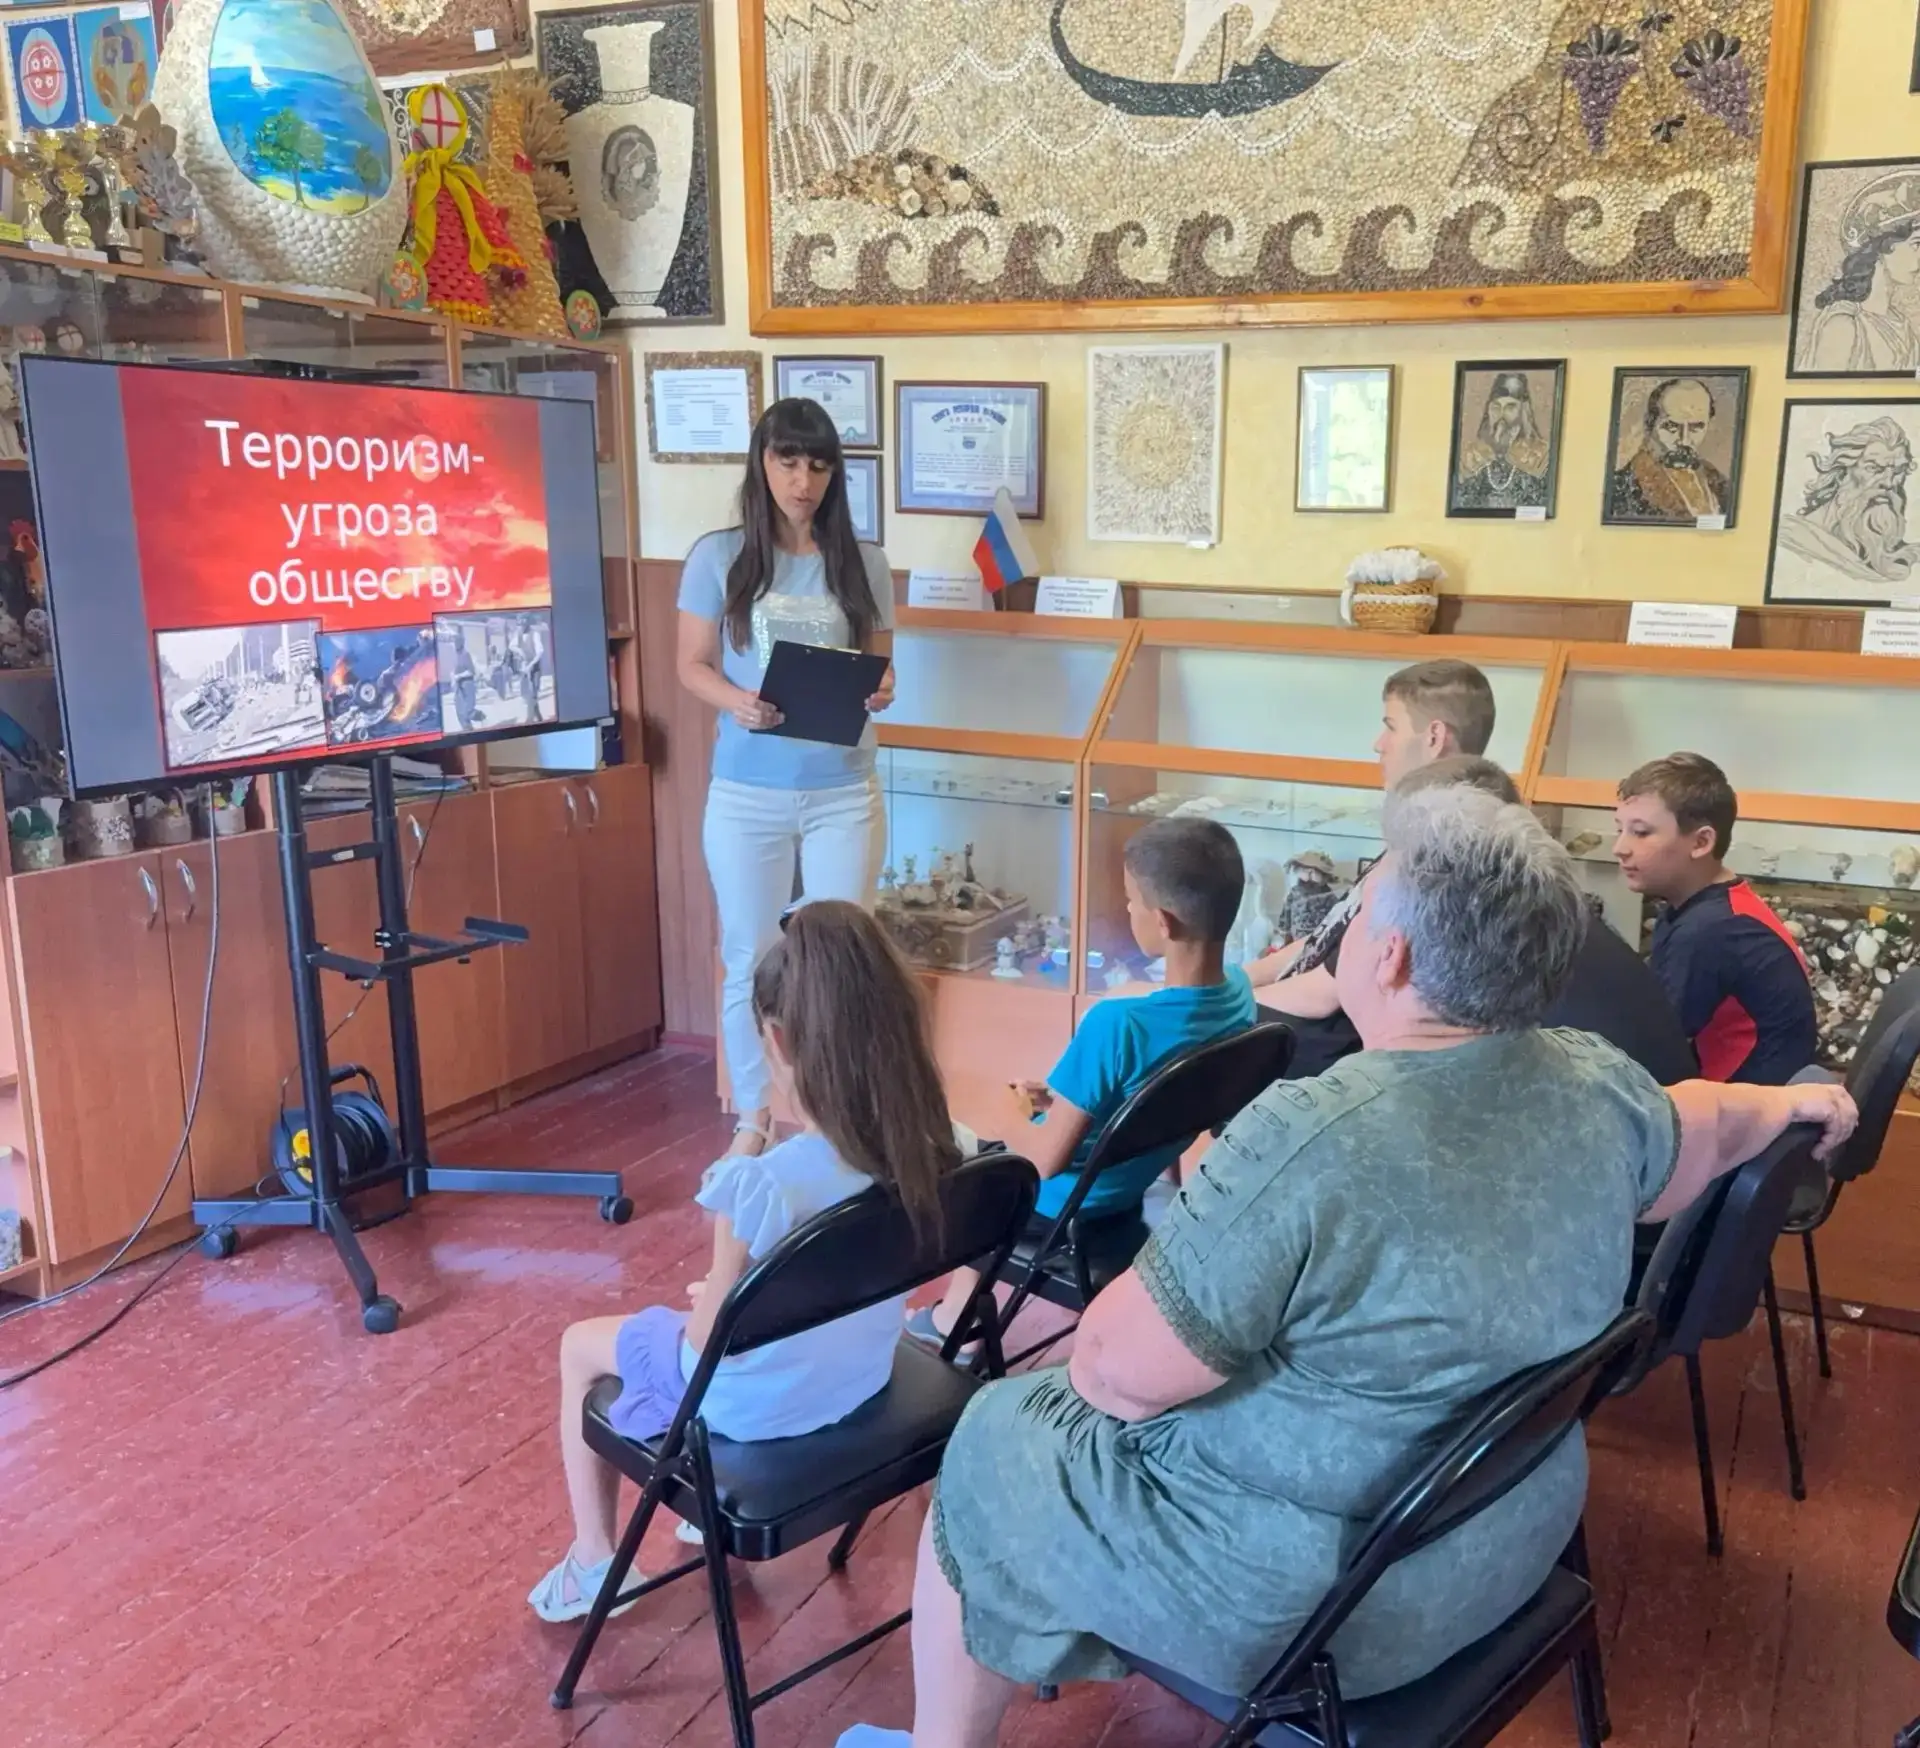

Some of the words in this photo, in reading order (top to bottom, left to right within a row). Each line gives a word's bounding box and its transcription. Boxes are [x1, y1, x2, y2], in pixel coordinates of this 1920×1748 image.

[204, 420, 485, 482] Терроризм-
[281, 502, 438, 549] угроза
[249, 559, 475, 608] обществу
